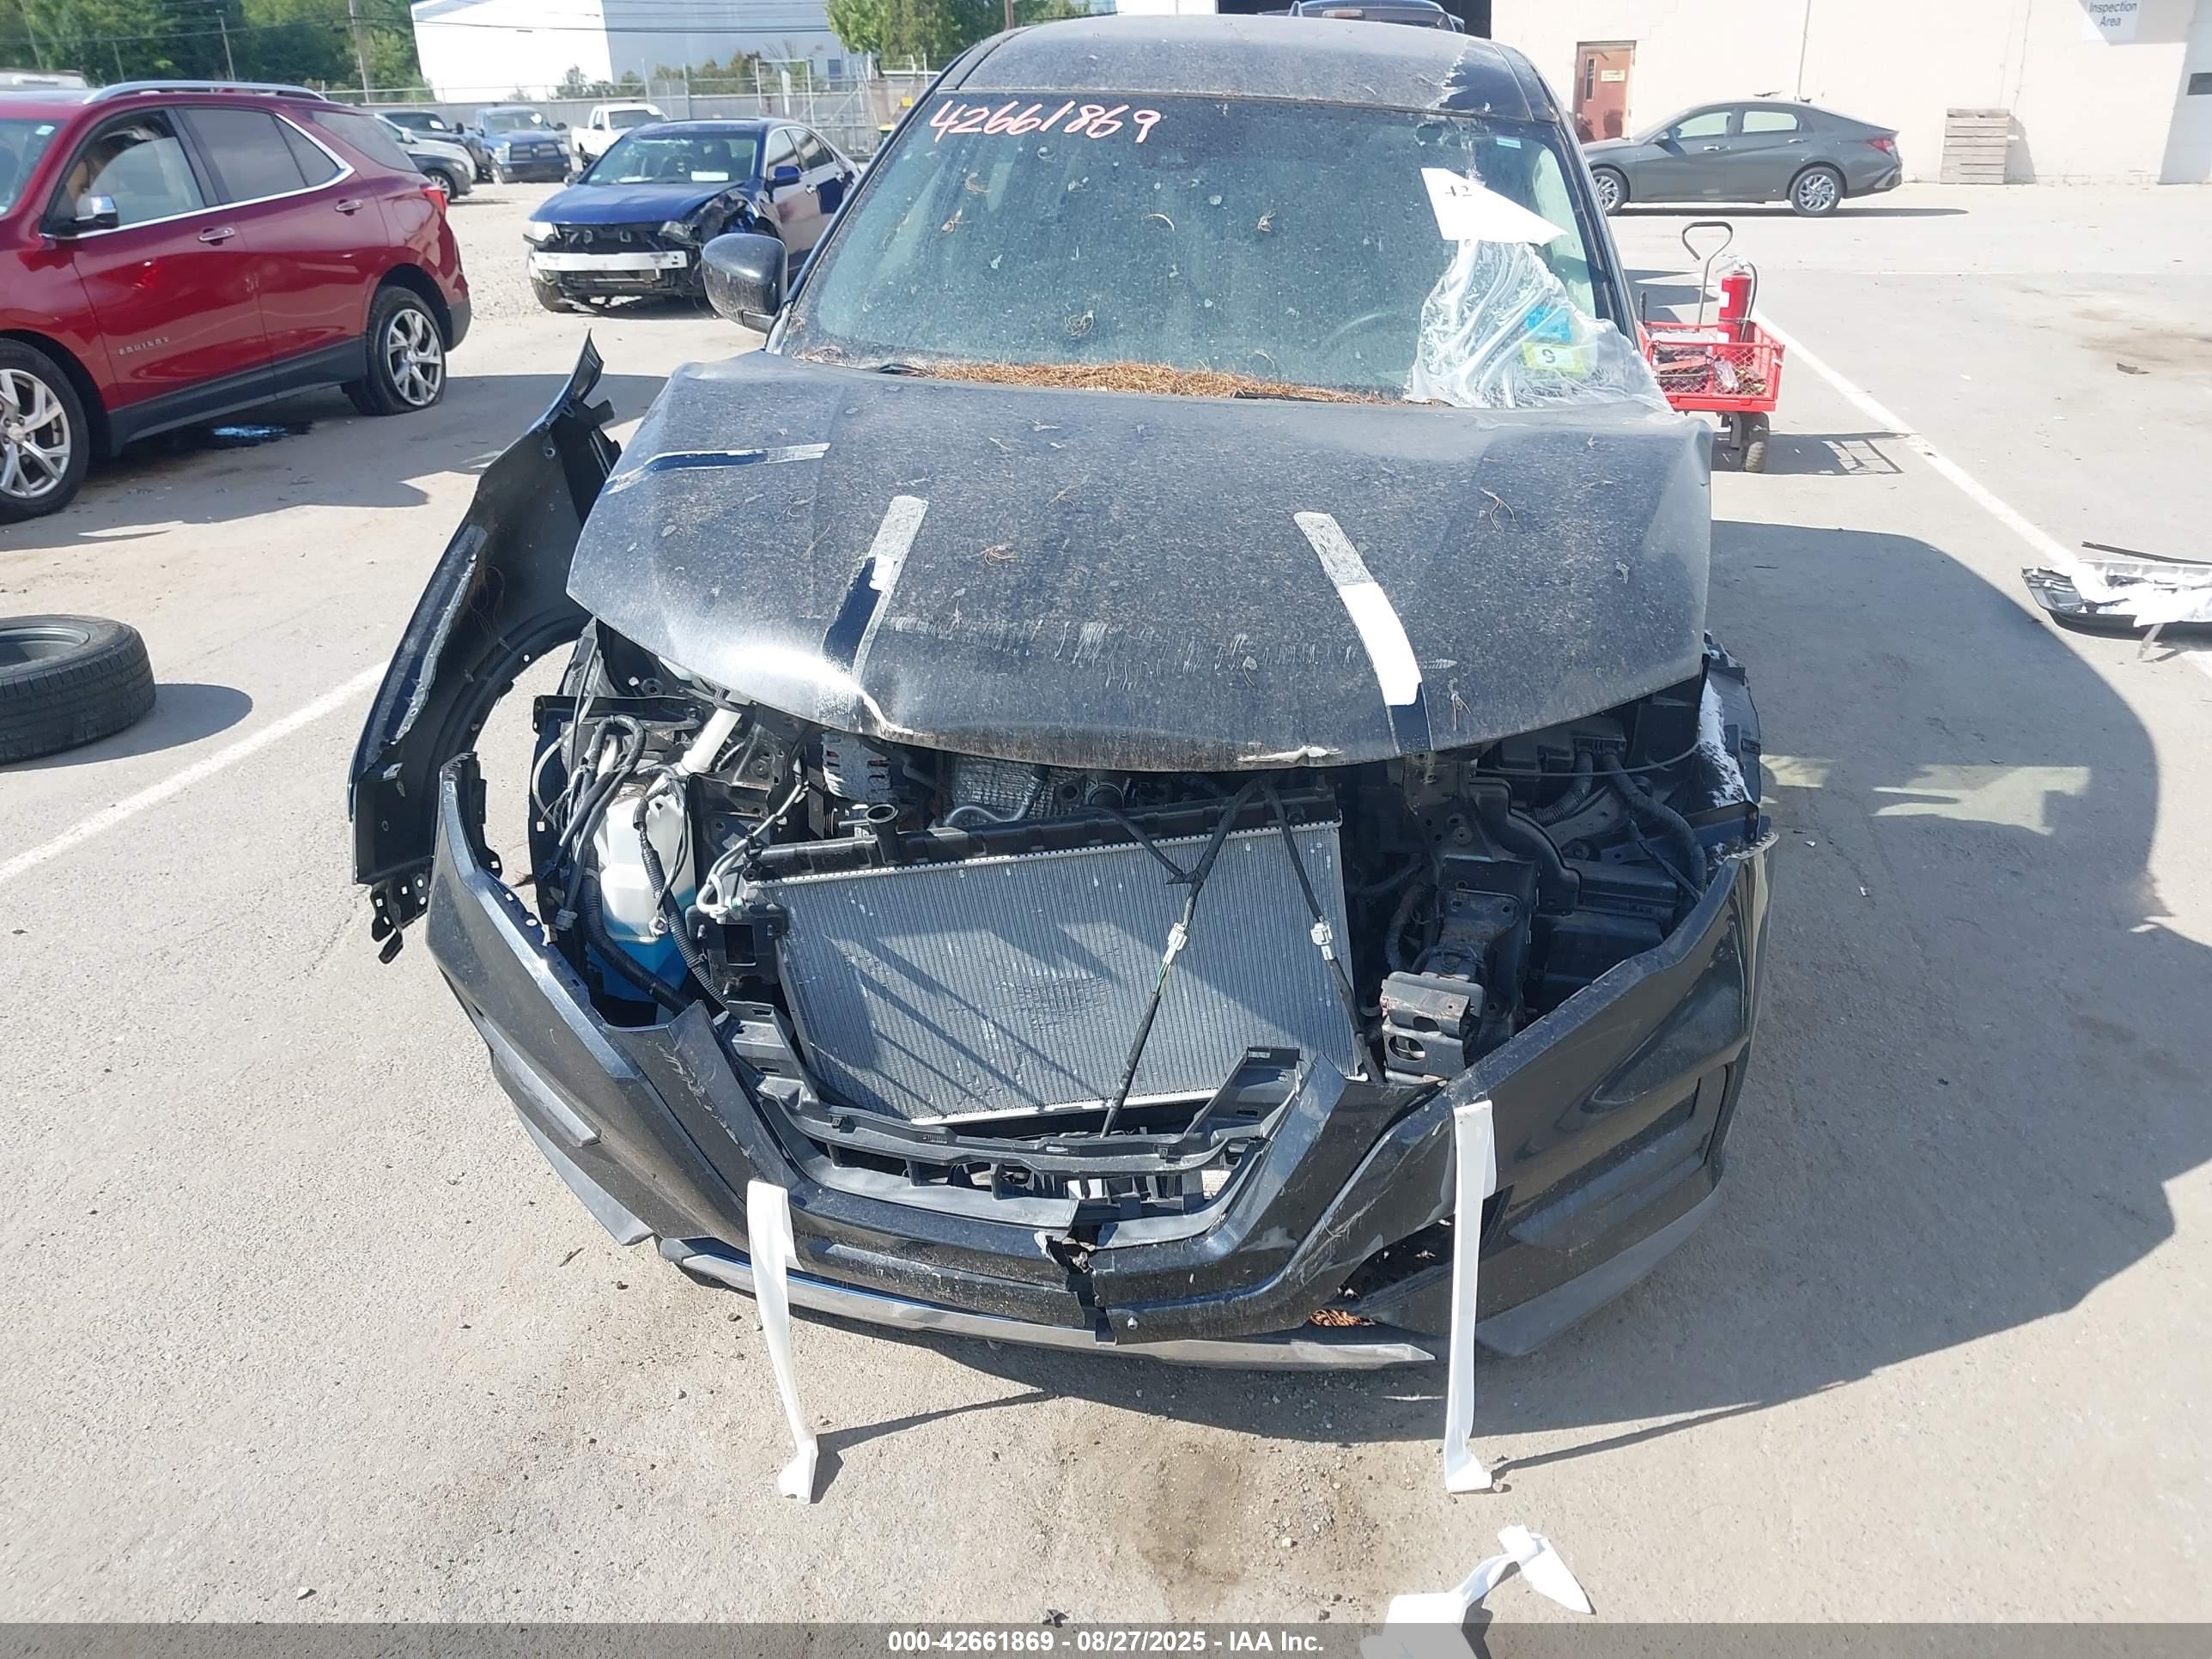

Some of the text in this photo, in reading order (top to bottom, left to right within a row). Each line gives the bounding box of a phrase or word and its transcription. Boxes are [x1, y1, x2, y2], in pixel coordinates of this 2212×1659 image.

[2088, 2, 2137, 14] Inspection
[2100, 15, 2122, 27] Area
[930, 100, 1162, 143] 42661869
[118, 337, 170, 356] EQUINOX
